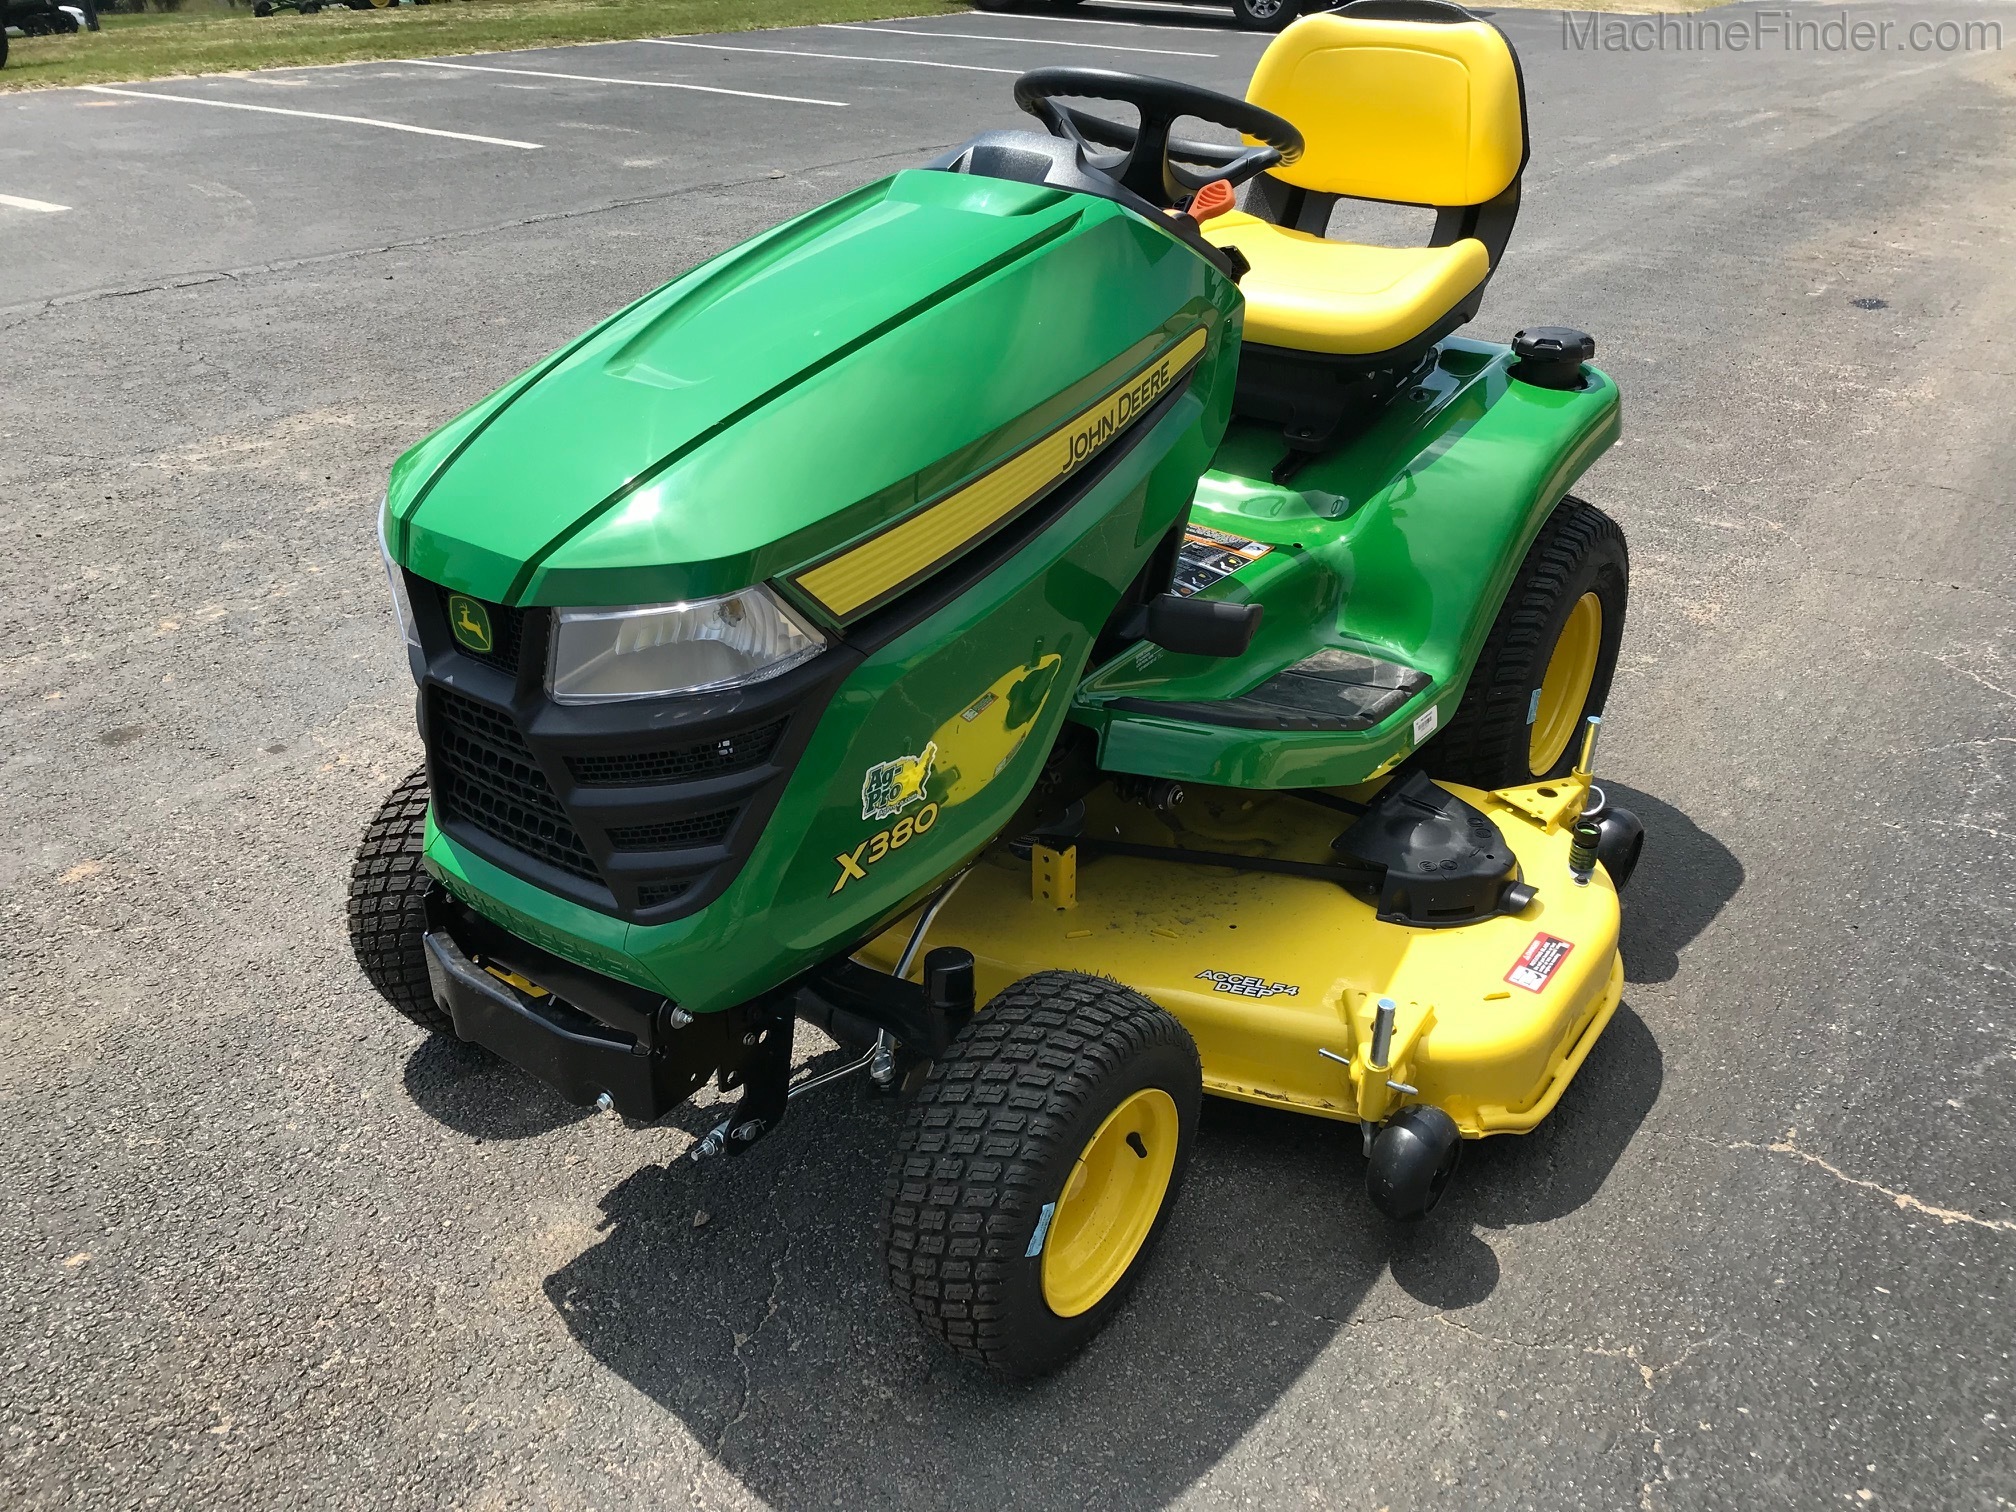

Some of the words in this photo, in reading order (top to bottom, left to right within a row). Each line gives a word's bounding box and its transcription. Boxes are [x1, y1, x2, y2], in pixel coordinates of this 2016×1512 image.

[1062, 409, 1115, 472] JOHN
[1118, 360, 1171, 427] DEERE
[865, 783, 903, 813] Pro
[828, 802, 940, 898] X380
[1194, 969, 1269, 989] ACCEL
[1270, 983, 1299, 996] 54
[1214, 982, 1275, 998] DEEP
